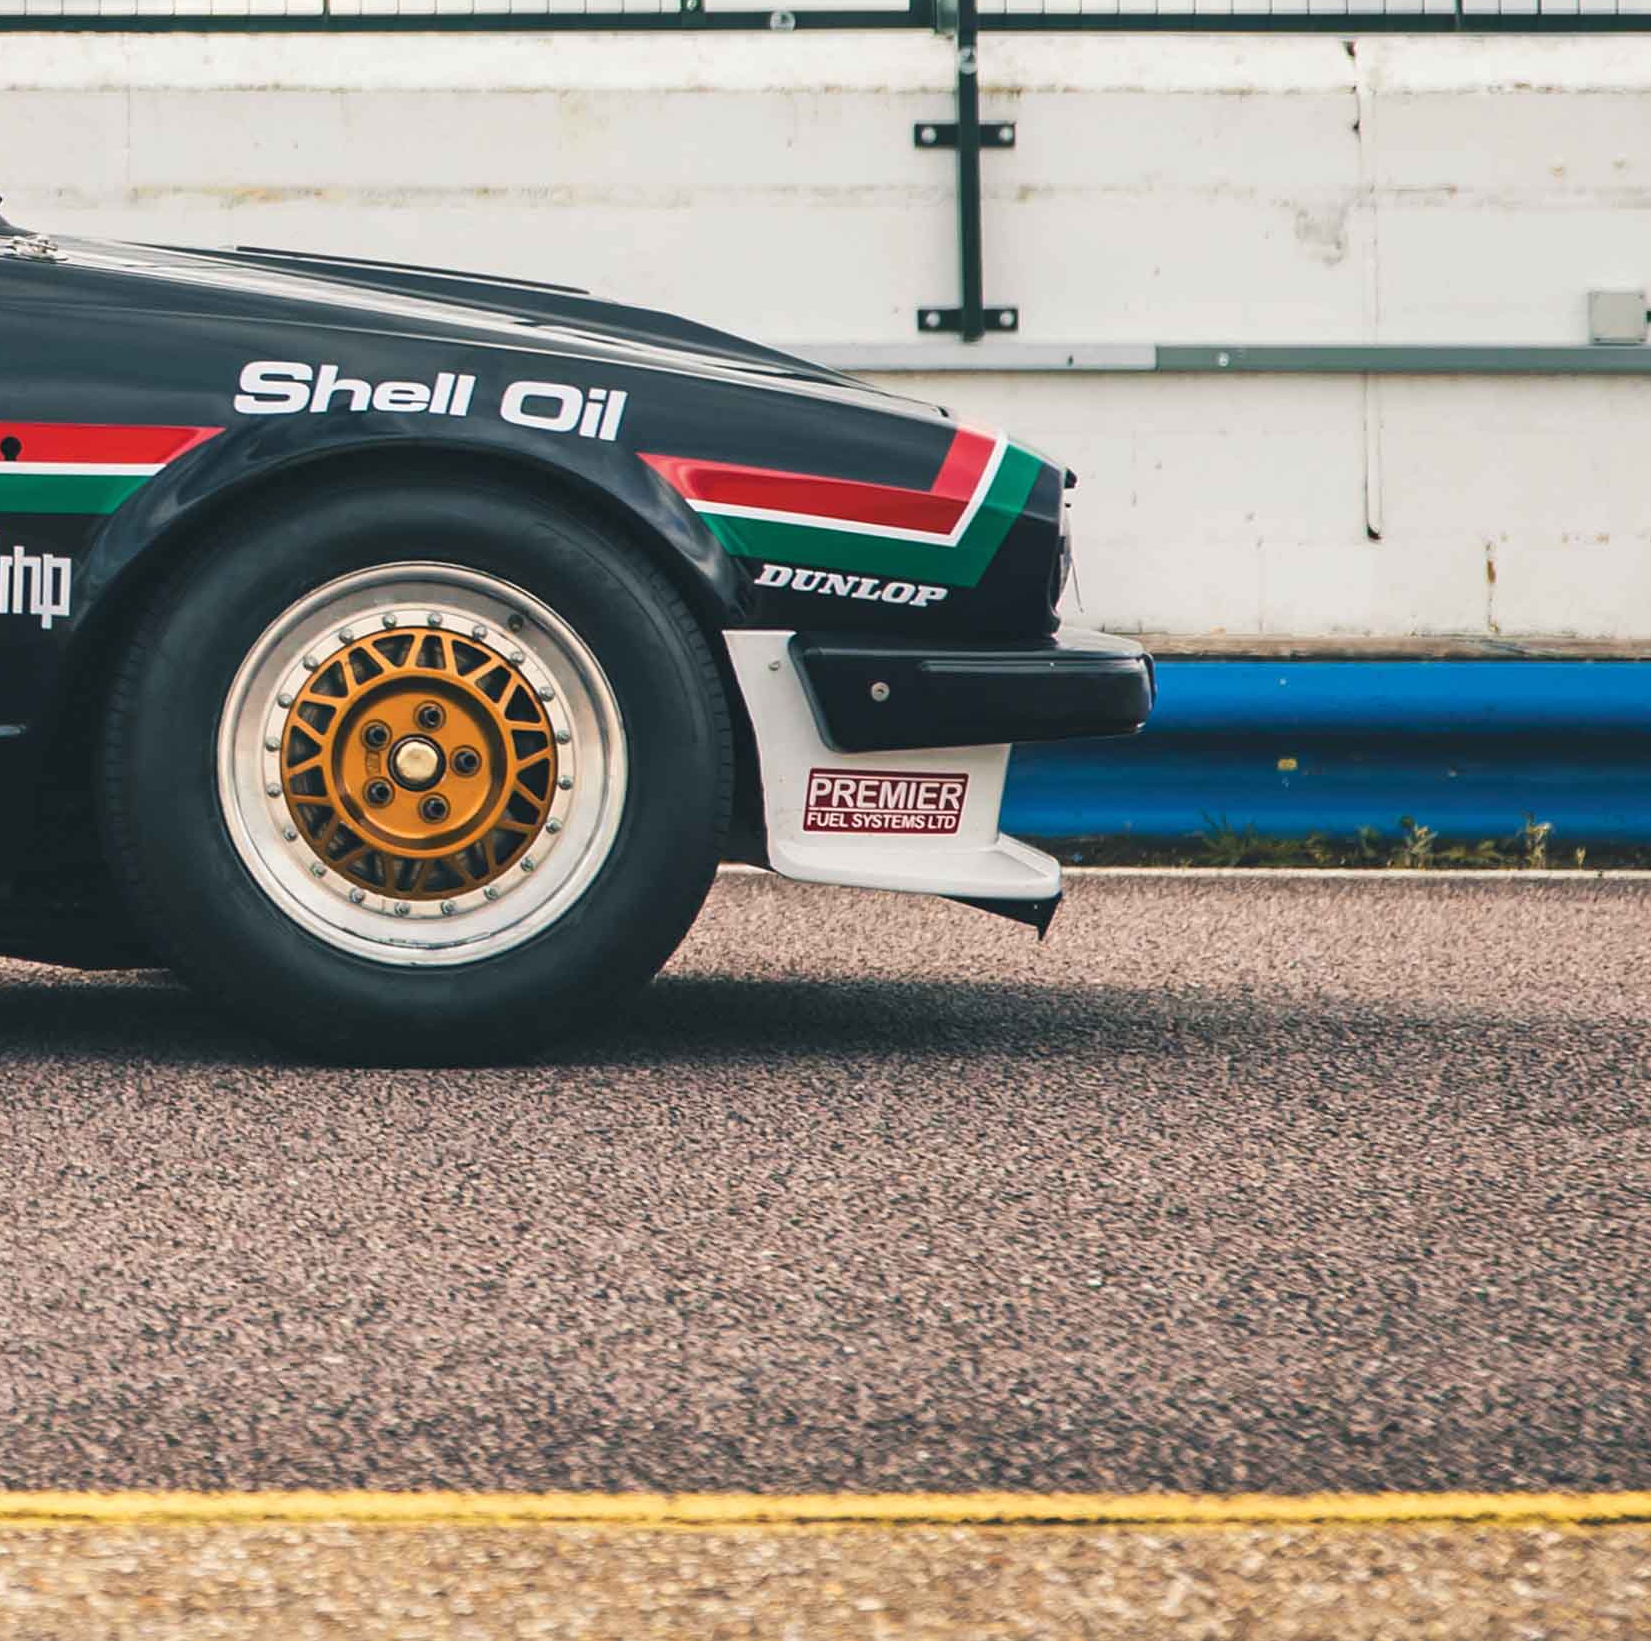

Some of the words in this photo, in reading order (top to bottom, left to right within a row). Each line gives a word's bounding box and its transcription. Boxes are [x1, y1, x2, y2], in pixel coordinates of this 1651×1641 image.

[233, 360, 477, 417] Shell
[500, 379, 628, 442] Oil
[753, 563, 949, 608] DUNLOP
[809, 778, 963, 809] PREMIER
[807, 811, 848, 828] FUEL
[851, 813, 925, 829] SYSTEMS
[927, 815, 957, 830] LTD
